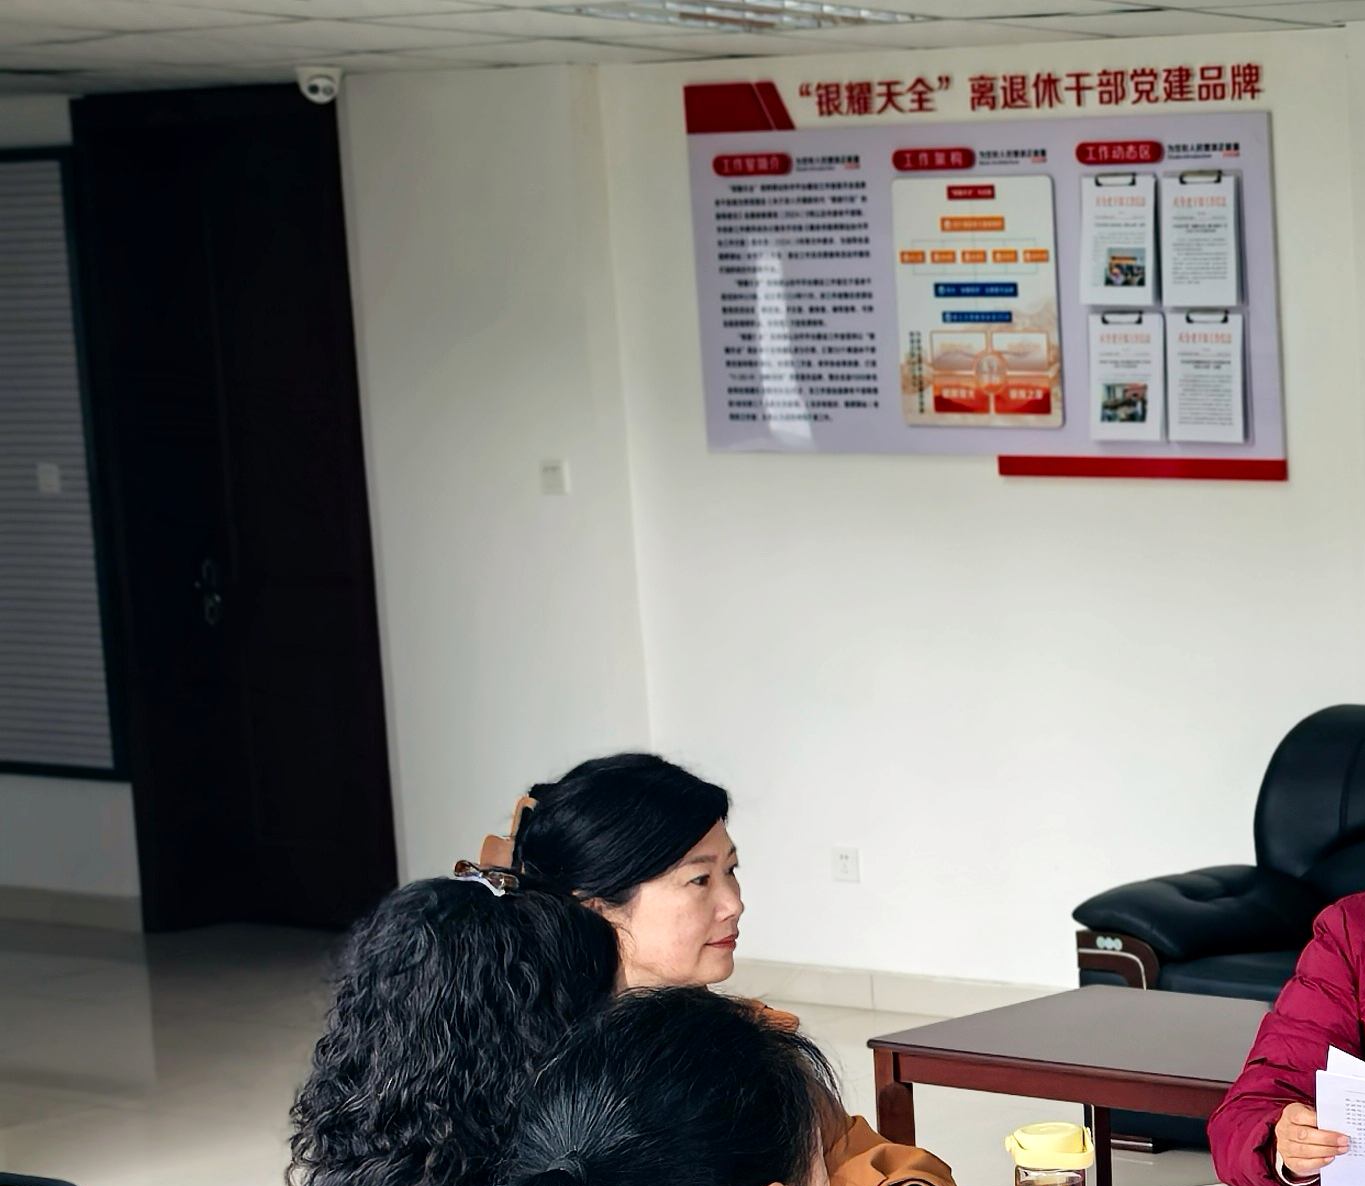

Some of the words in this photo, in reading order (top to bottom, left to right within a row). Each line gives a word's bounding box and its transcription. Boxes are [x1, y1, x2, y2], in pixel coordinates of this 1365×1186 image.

[904, 151, 963, 168] 工作架构
[1086, 144, 1151, 161] 工作动态区
